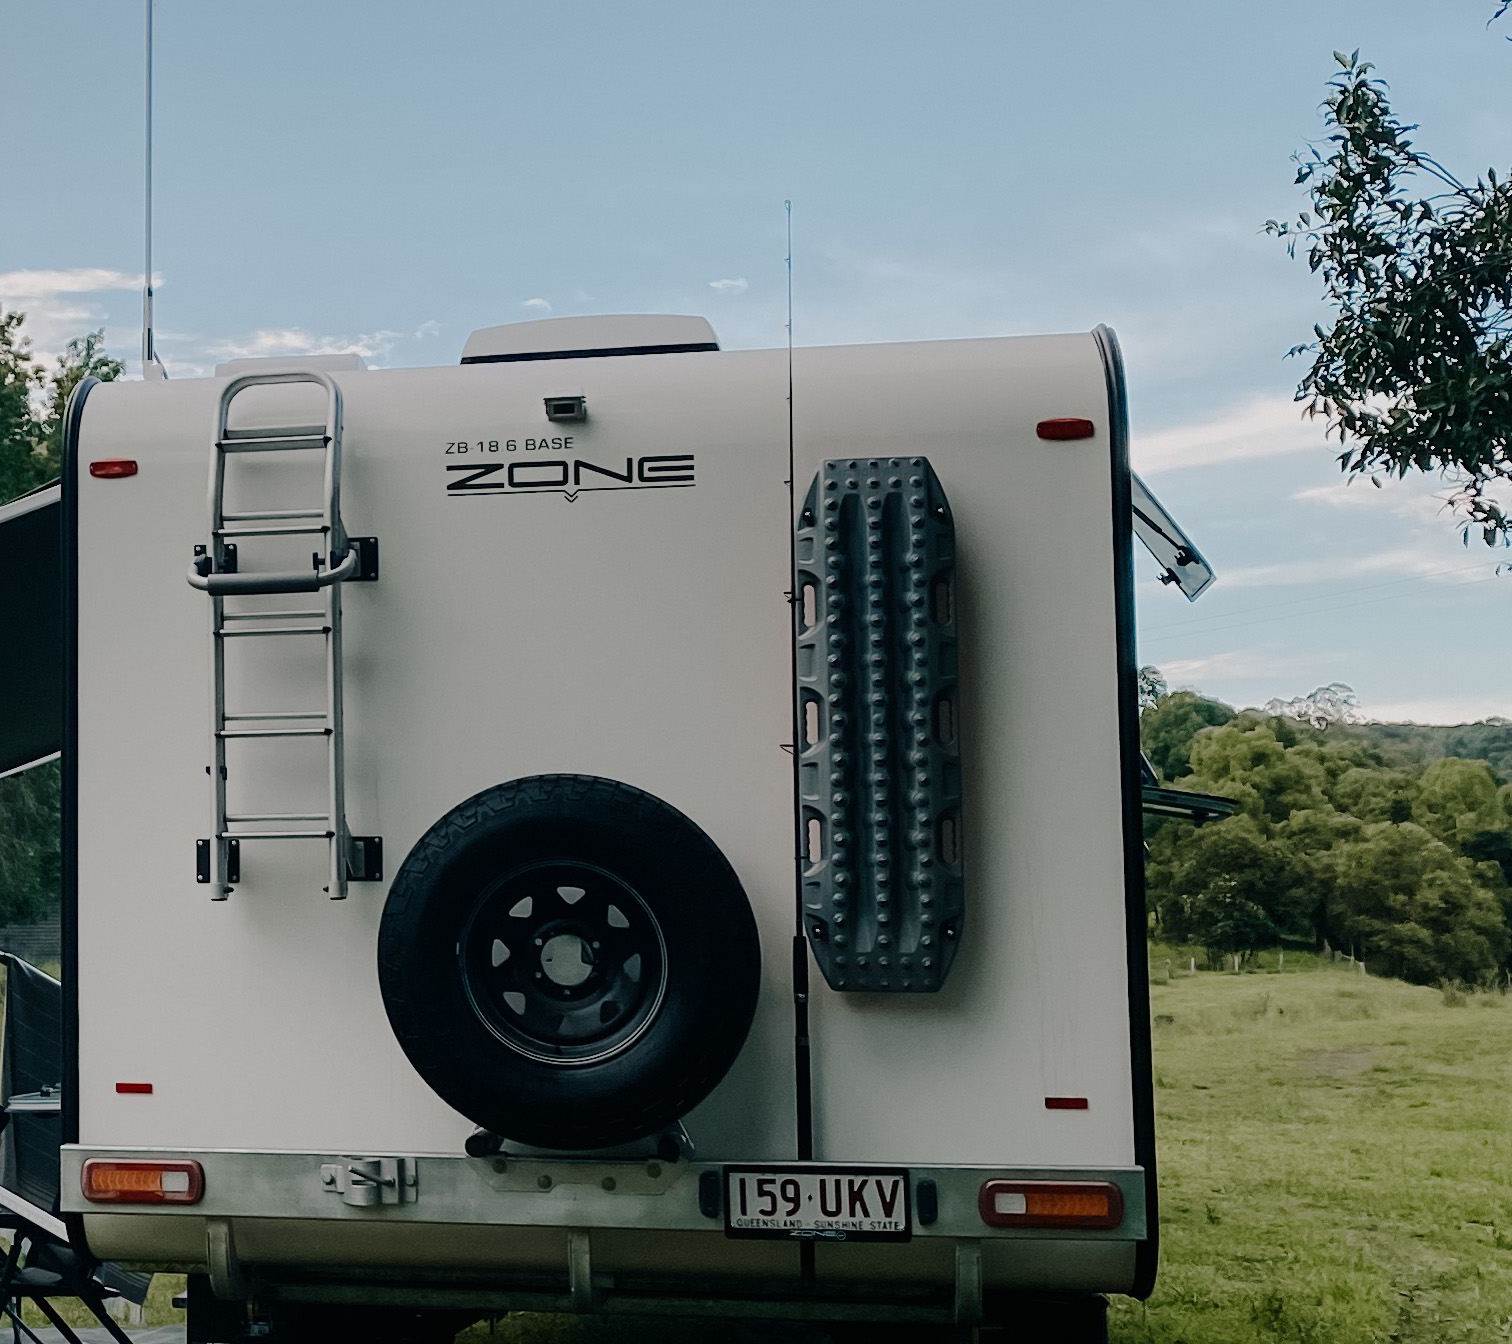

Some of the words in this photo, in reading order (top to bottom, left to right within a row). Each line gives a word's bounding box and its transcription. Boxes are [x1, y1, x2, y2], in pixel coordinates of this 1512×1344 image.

[525, 436, 574, 451] BASE
[446, 455, 694, 490] ZONE
[736, 1218, 802, 1228] QUEENSLAND
[814, 1220, 863, 1230] SUNSHINE
[870, 1221, 899, 1231] STATE
